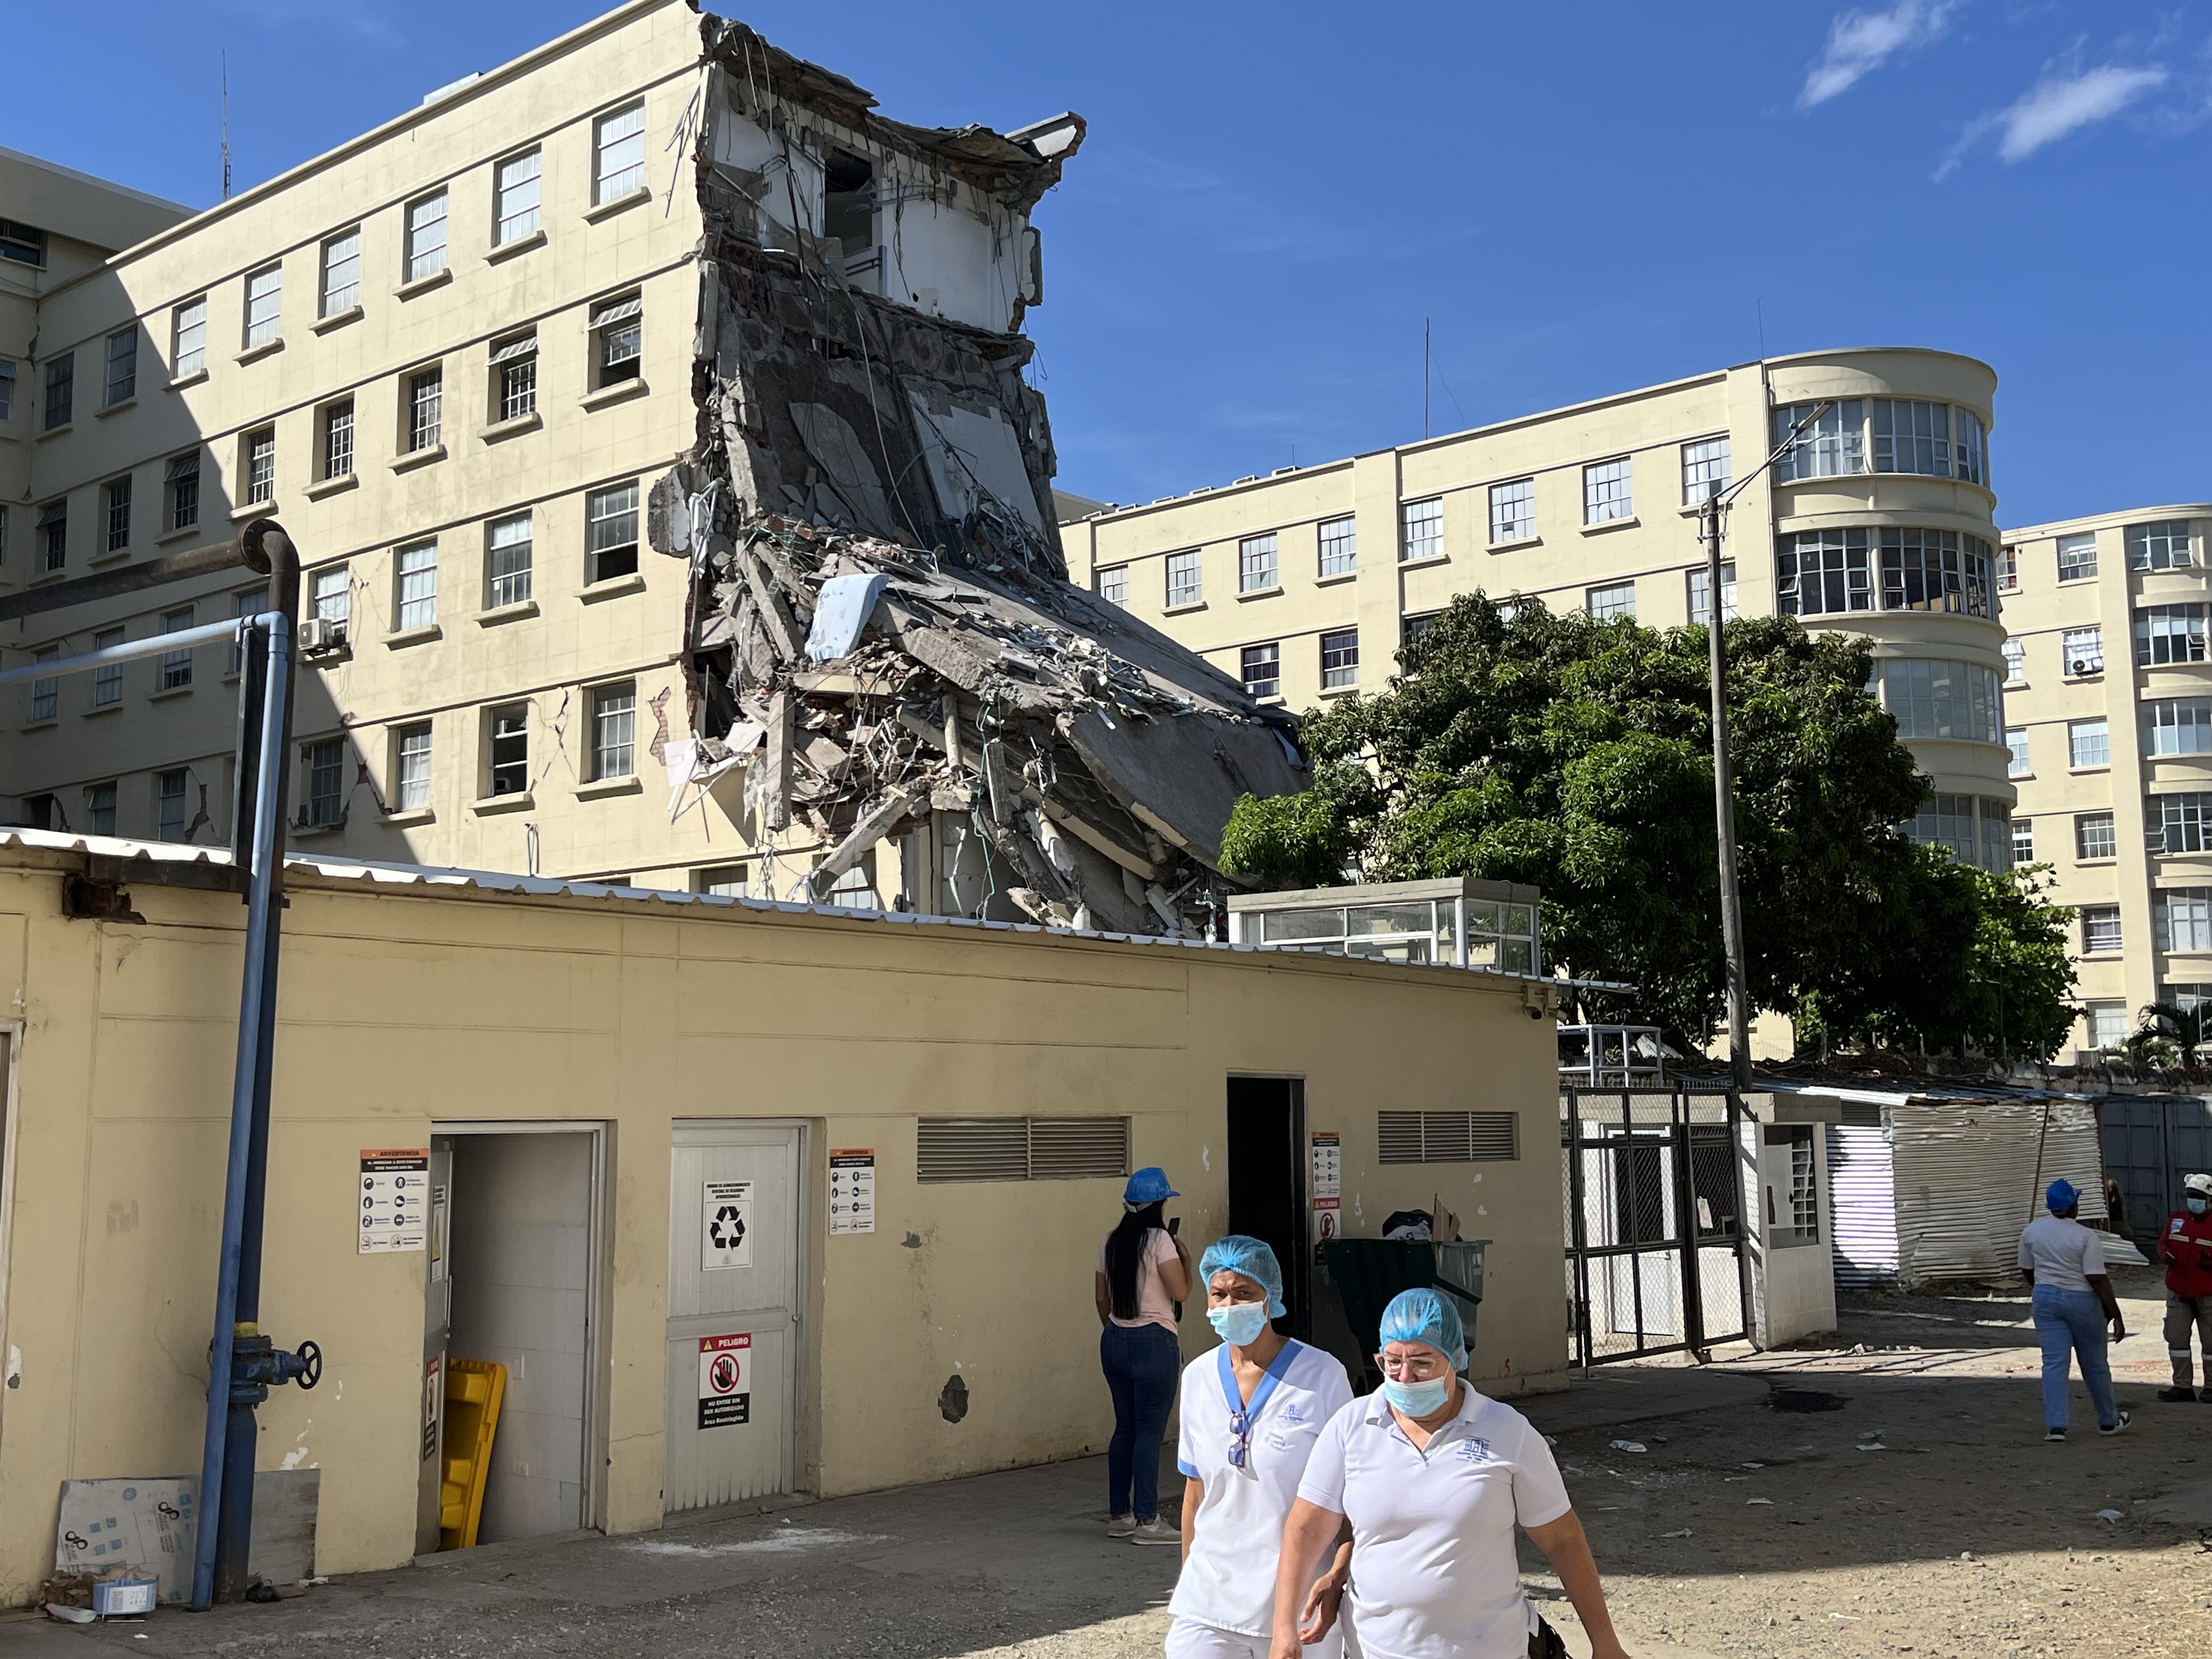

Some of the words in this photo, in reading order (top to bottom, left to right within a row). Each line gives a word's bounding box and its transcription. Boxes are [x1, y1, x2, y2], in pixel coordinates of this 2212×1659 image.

[718, 1337, 749, 1348] PELIGRO
[714, 1404, 744, 1413] AUTORIZADO
[716, 1414, 744, 1424] Restringido
